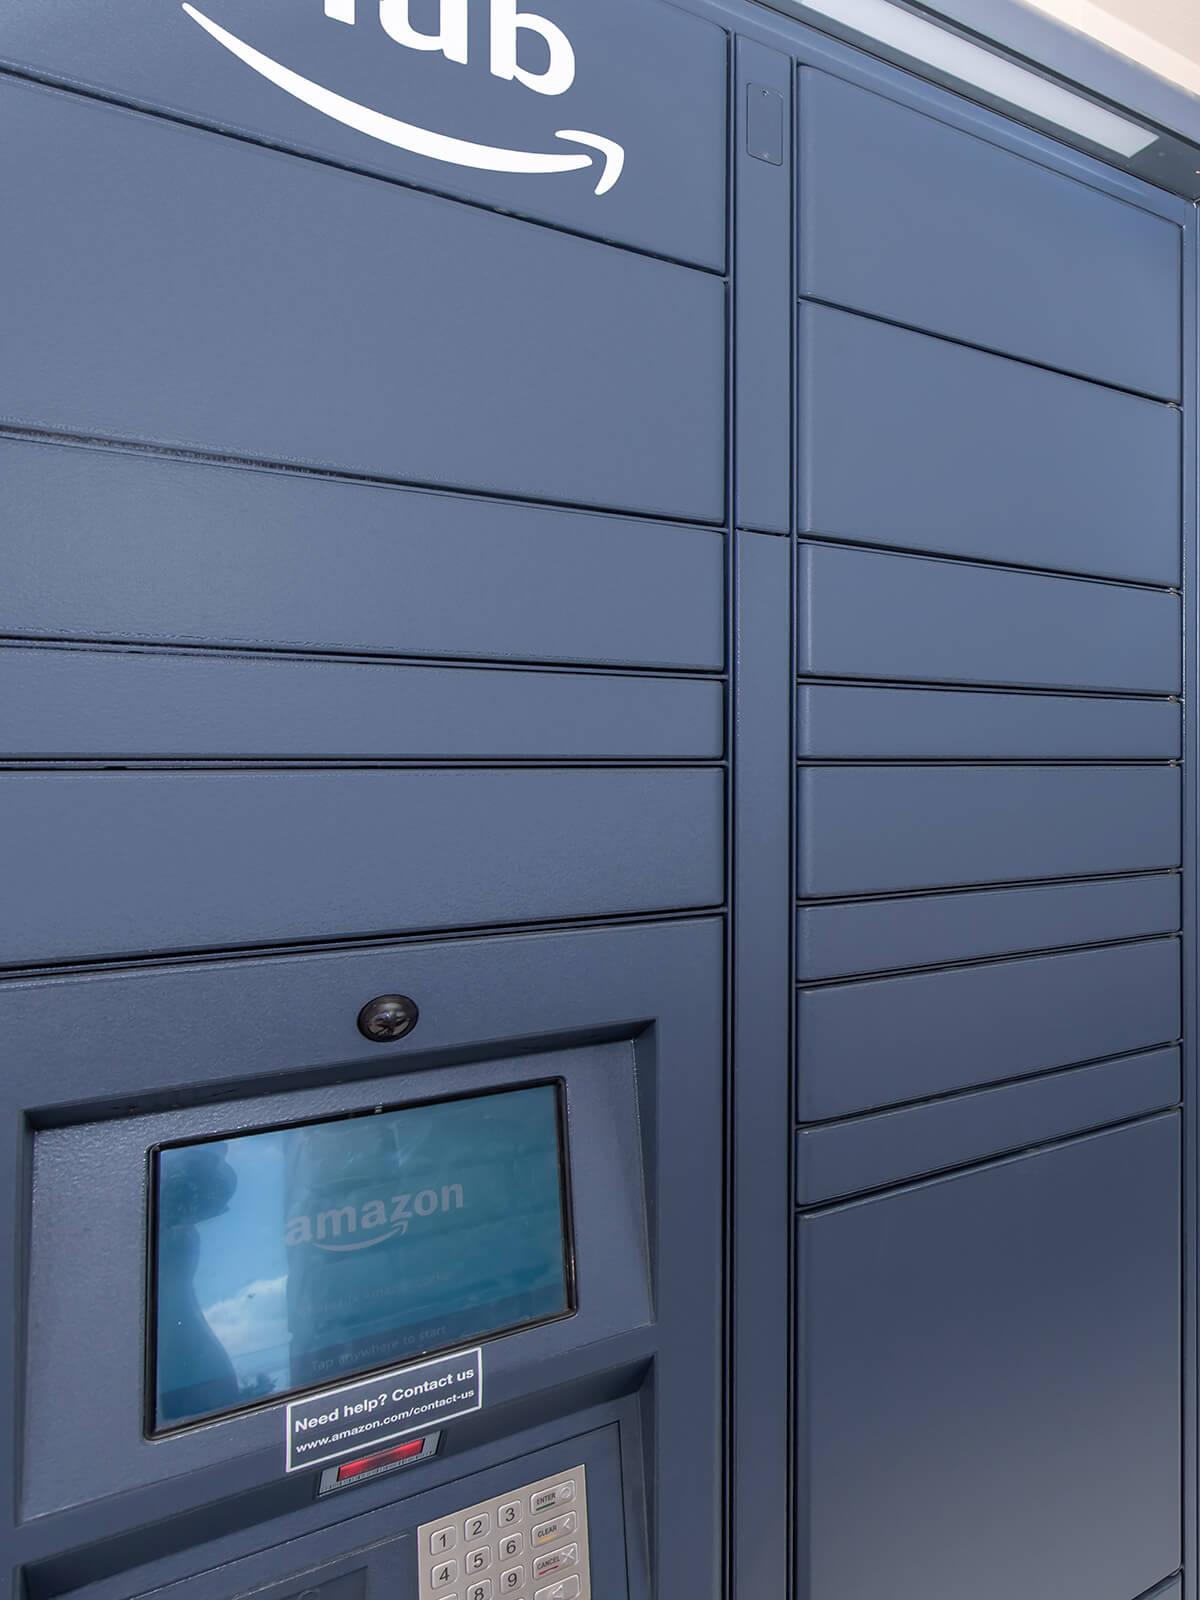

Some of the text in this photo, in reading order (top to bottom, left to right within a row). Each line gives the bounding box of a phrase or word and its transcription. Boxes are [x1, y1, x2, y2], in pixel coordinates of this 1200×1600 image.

[324, 0, 576, 96] ub
[285, 1183, 464, 1246] amazon
[294, 1368, 475, 1433] Need help? Contact us
[295, 1389, 475, 1454] www.amazon.com/contact-us
[536, 1492, 556, 1505] ENTER
[505, 1507, 516, 1523] 3
[472, 1520, 483, 1536] 2
[537, 1525, 558, 1538] CLEAR
[439, 1533, 448, 1548] 1
[506, 1540, 517, 1554] 6
[473, 1553, 484, 1569] 5
[537, 1556, 560, 1569] CANCEL
[439, 1567, 449, 1581] 4
[507, 1572, 518, 1587] 9
[474, 1587, 484, 1600] 8
